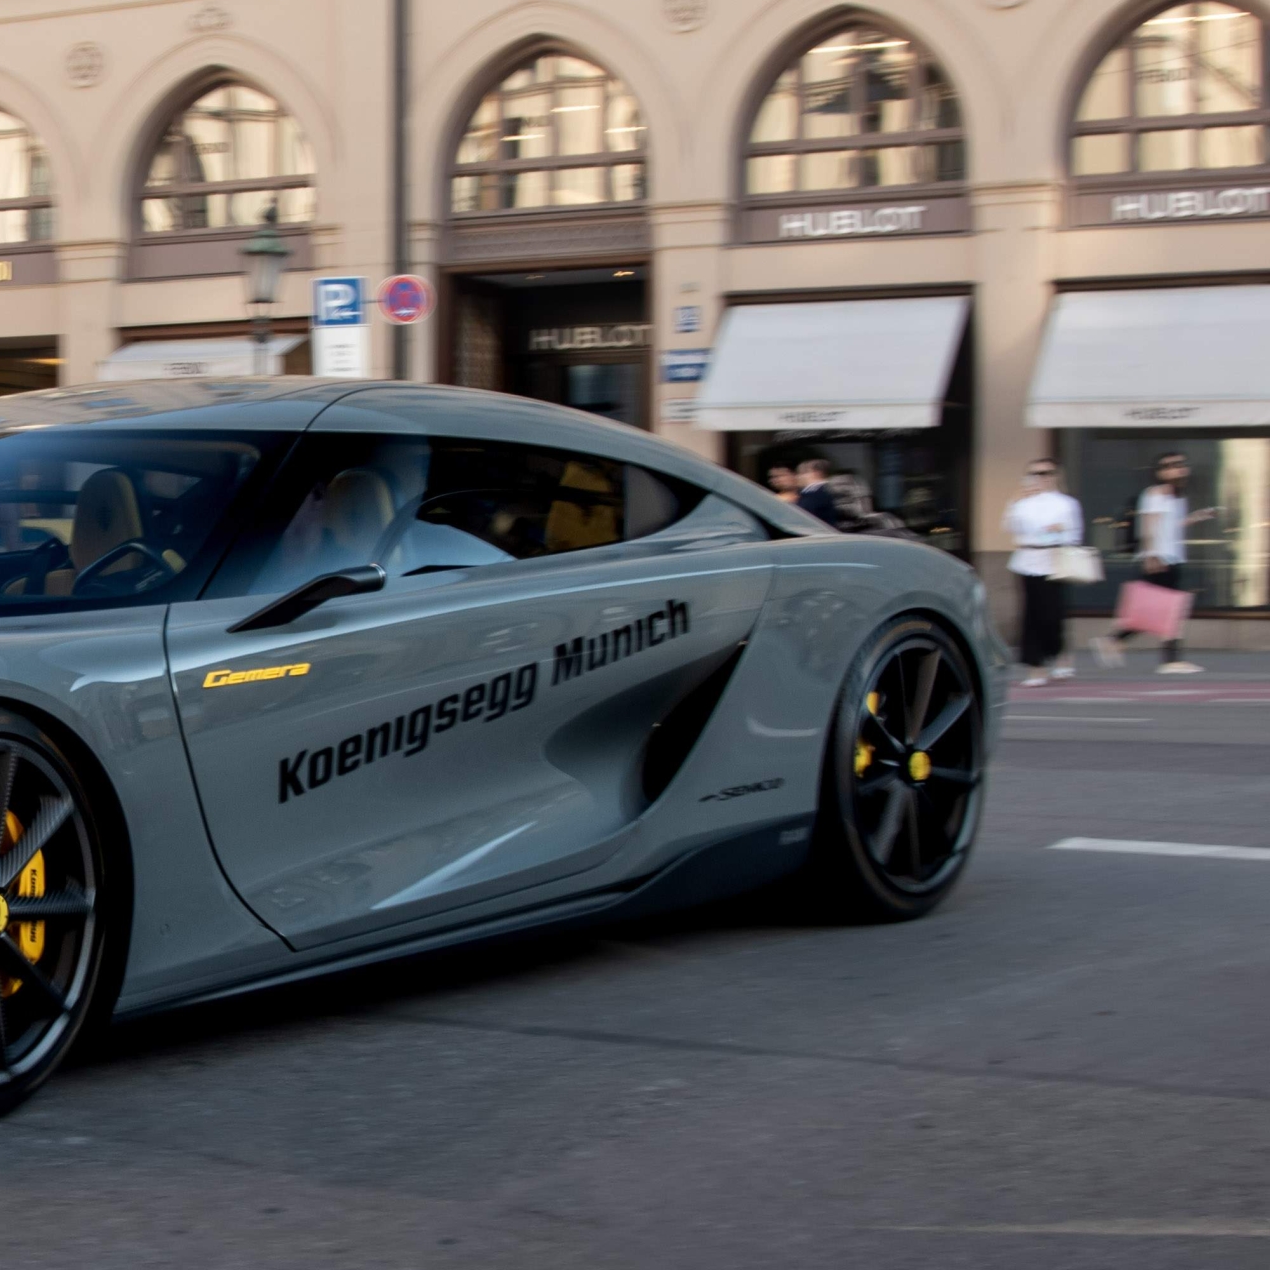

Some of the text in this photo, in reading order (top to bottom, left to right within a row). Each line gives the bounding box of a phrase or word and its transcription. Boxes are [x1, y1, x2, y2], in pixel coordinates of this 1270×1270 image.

[1111, 187, 1270, 221] HUBLOT
[779, 205, 928, 238] HUBLOT
[317, 283, 356, 321] P
[529, 323, 655, 351] HUBLOT
[202, 662, 311, 688] Gemera
[277, 599, 692, 804] Koenigsegg Munich
